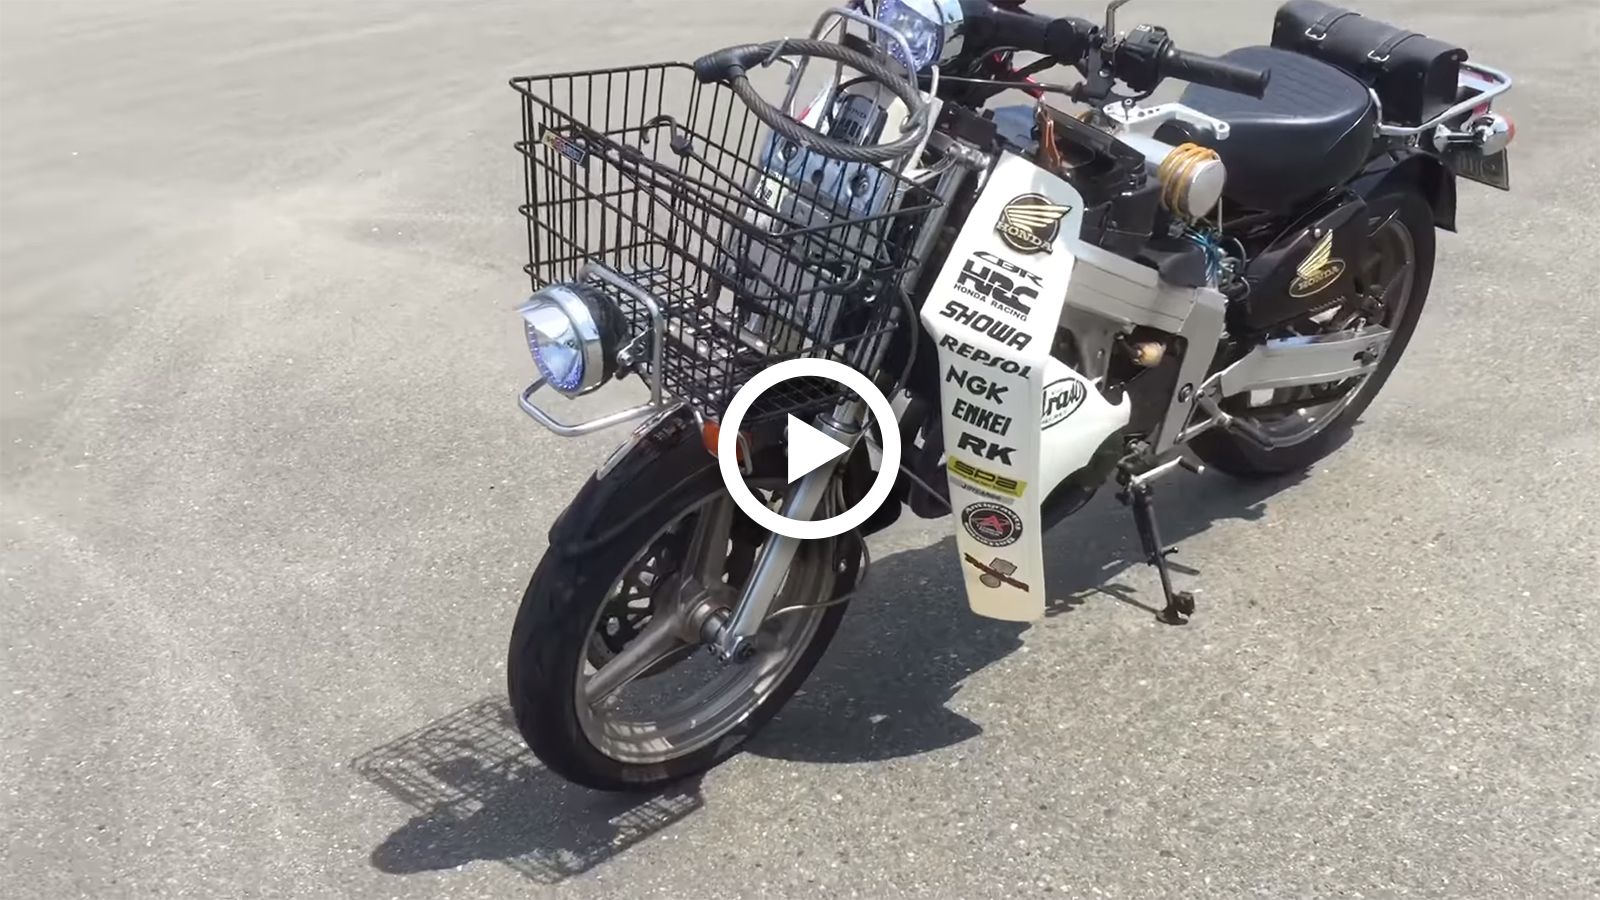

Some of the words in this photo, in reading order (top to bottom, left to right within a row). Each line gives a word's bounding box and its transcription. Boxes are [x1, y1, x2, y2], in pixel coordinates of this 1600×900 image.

[996, 221, 1052, 252] HONDA
[957, 258, 1039, 315] HRC
[973, 251, 1044, 288] CBR
[954, 283, 986, 302] HONDA
[990, 300, 1028, 322] RACING
[939, 300, 1032, 351] SHOWA
[939, 334, 1031, 379] REPSOL
[945, 364, 1008, 405] NGK
[951, 398, 1012, 436] ENKEI
[957, 431, 1016, 466] RK
